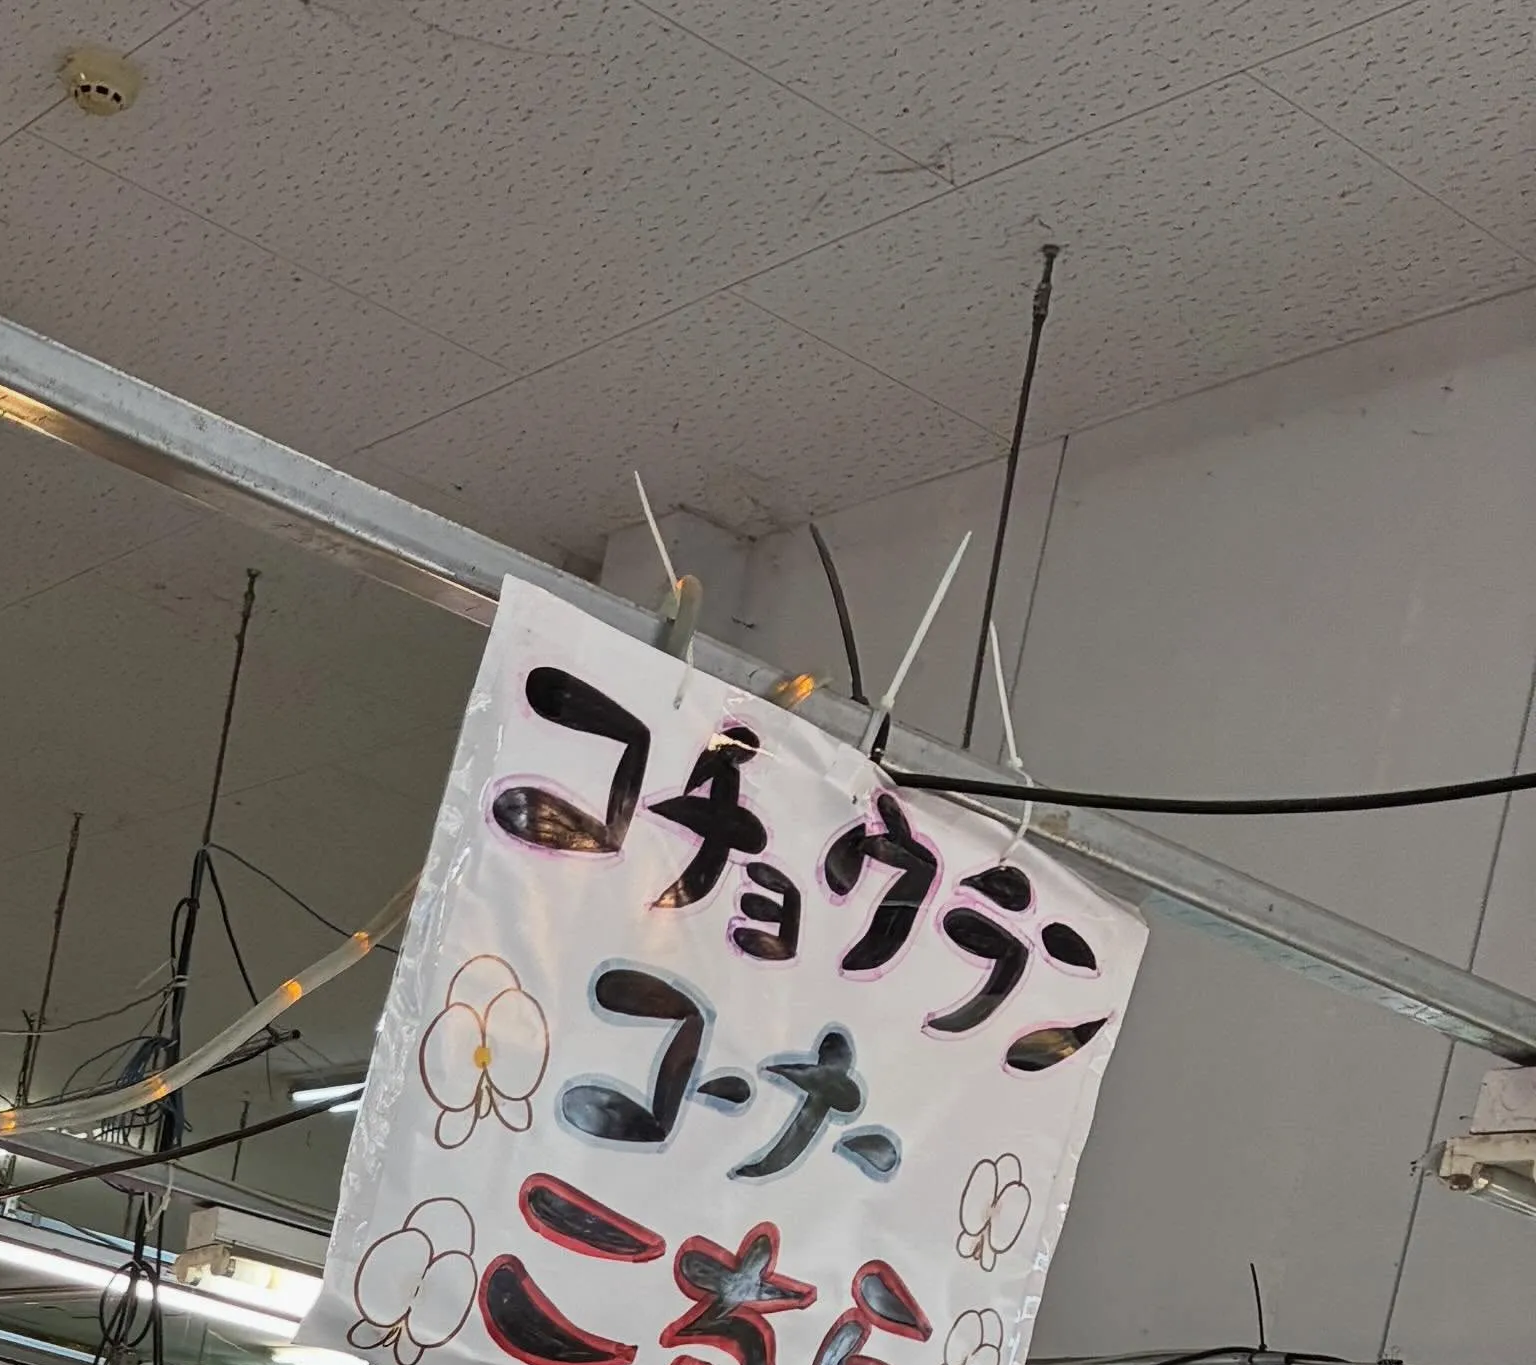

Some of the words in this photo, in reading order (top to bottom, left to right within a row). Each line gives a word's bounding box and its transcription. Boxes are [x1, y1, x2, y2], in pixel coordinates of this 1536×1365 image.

[491, 664, 1113, 1074] コチョウラン
[558, 964, 902, 1182] コーナー
